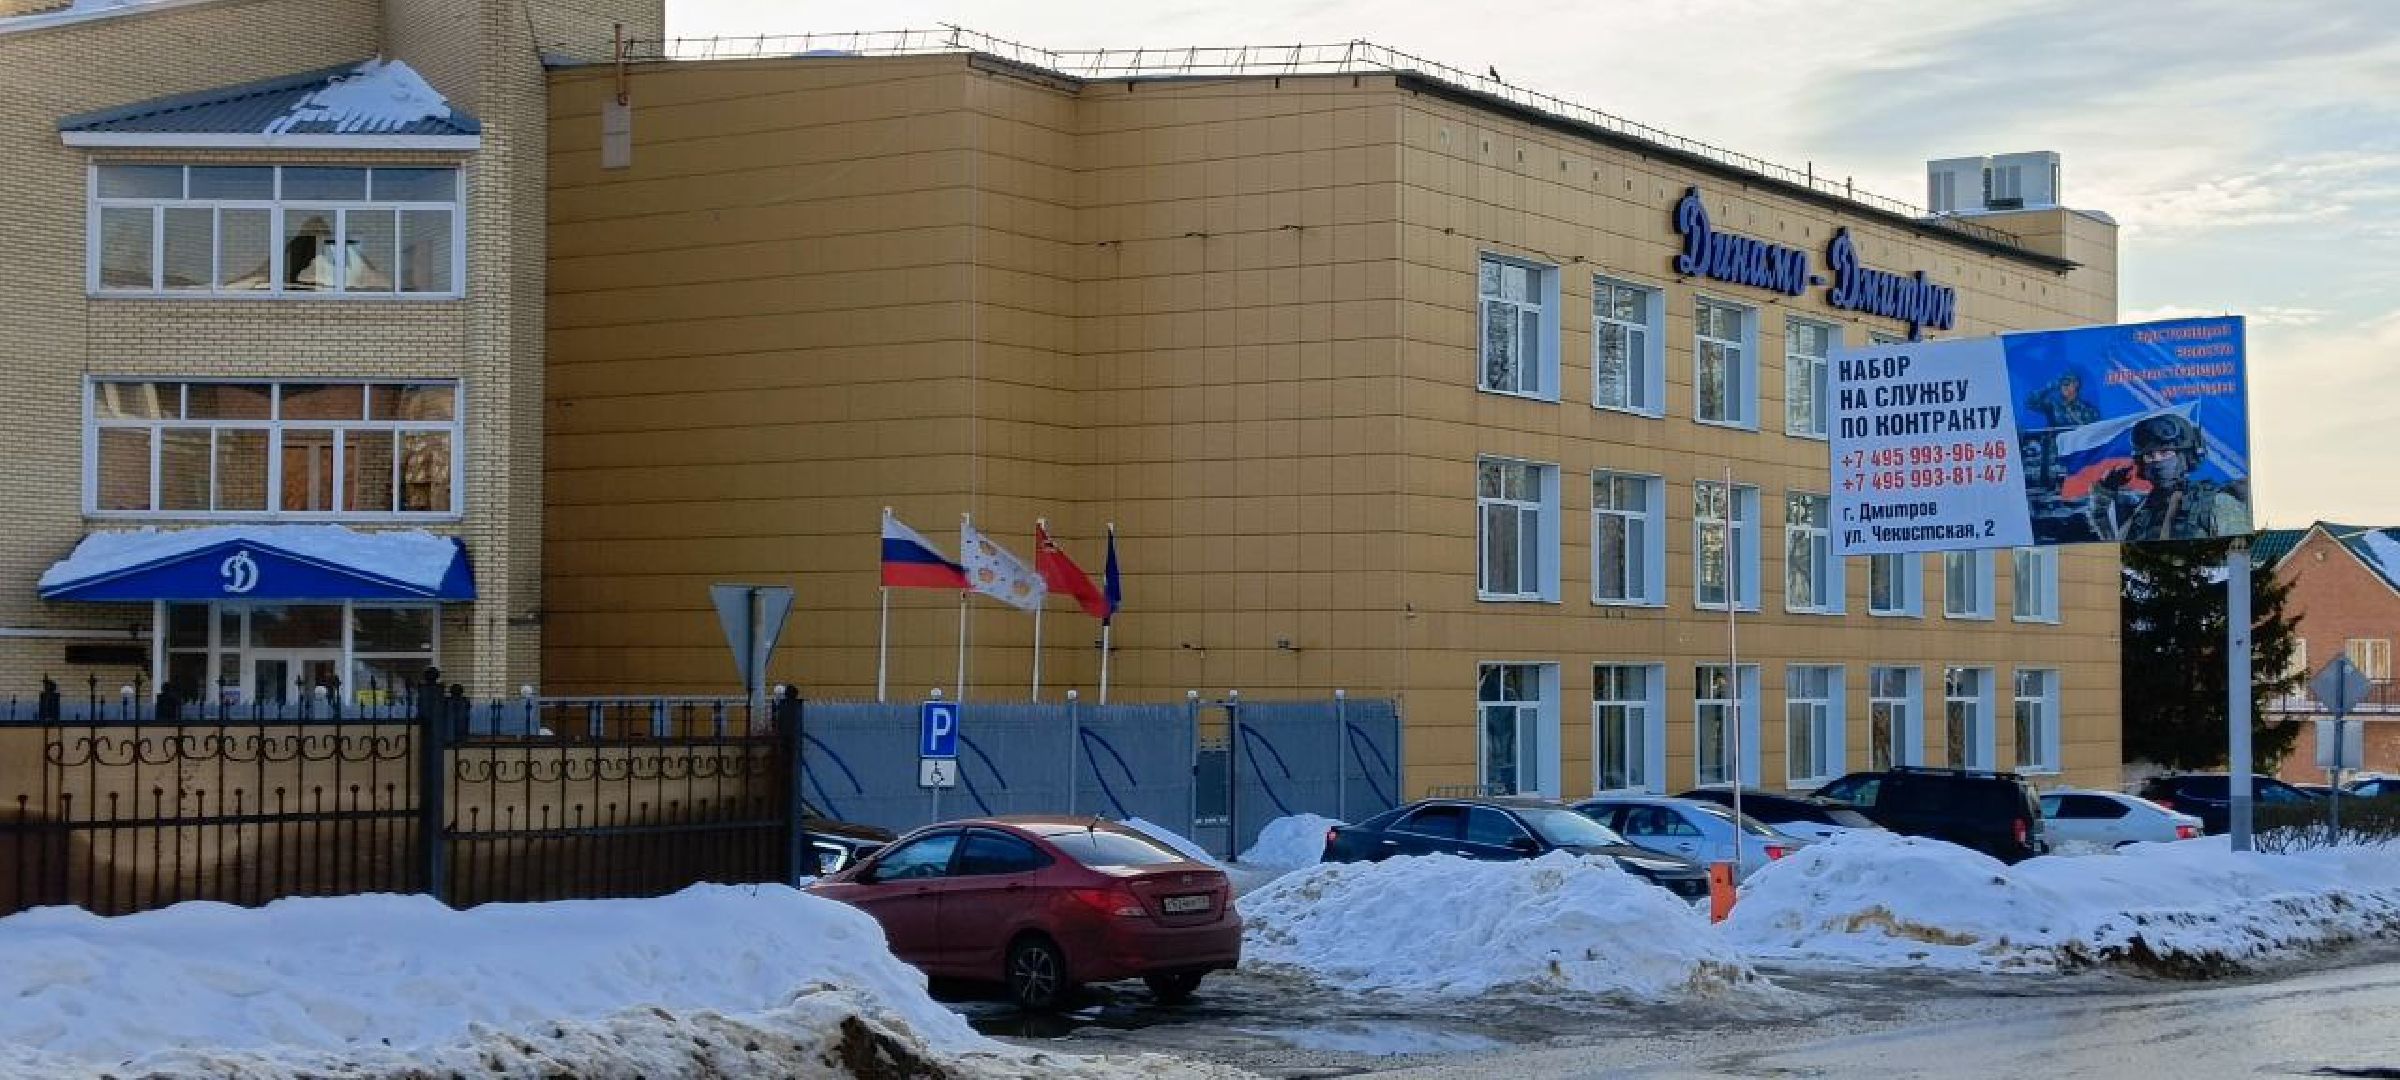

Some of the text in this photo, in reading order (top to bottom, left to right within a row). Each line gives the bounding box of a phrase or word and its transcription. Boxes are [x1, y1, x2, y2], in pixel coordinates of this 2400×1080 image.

[1674, 185, 1808, 296] Динамо
[1839, 355, 1911, 382] НАБОР
[1840, 380, 1969, 411] НА СЛУЖБУ
[1840, 405, 2002, 439] ПО КОНТРАКТУ
[1841, 450, 1864, 469] +7
[1871, 448, 1904, 467] 495
[1842, 464, 2007, 491] +7 495 993-81-47
[1843, 502, 1938, 523] г. Дмитров
[1844, 518, 1996, 547] ул. Чекистская, 2
[931, 707, 951, 751] P
